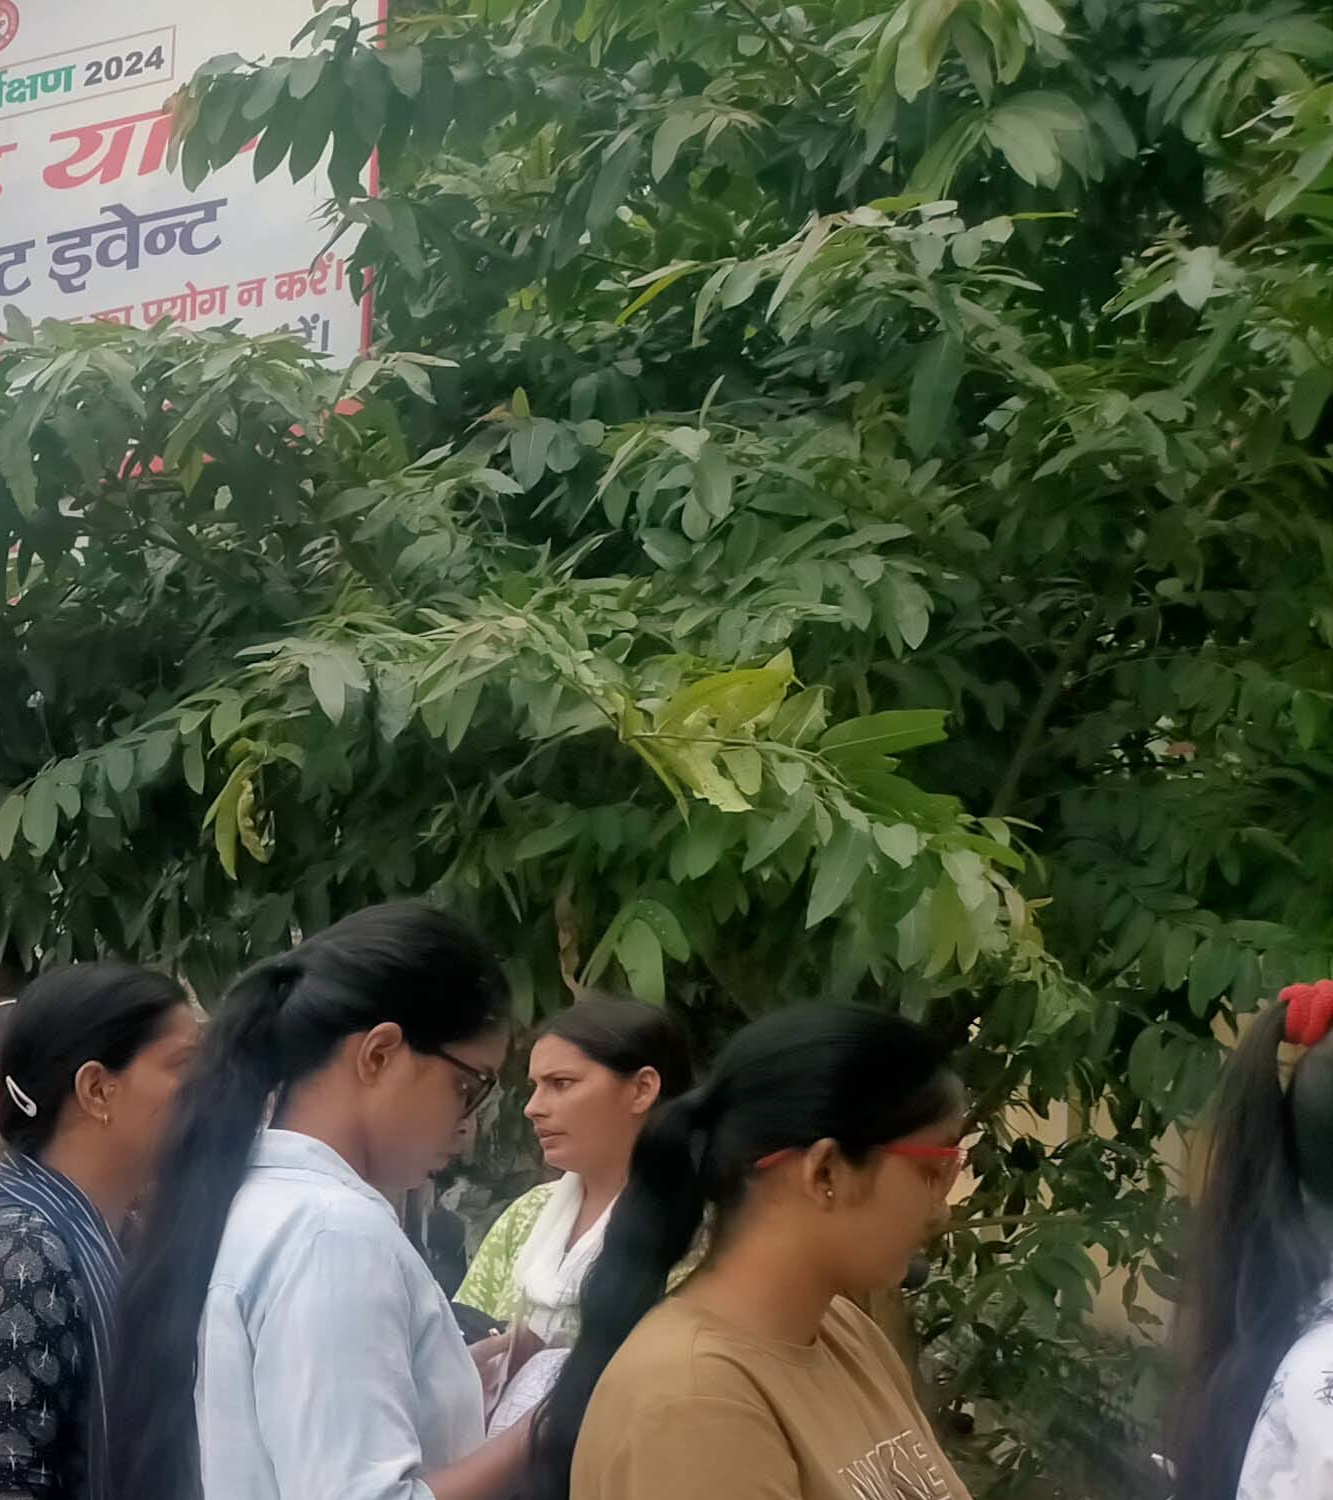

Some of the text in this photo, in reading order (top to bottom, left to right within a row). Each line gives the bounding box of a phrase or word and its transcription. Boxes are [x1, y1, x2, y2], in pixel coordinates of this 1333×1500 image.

[83, 45, 165, 87] 2024
[46, 197, 228, 294] इवेन्ट
[237, 278, 267, 307] न
